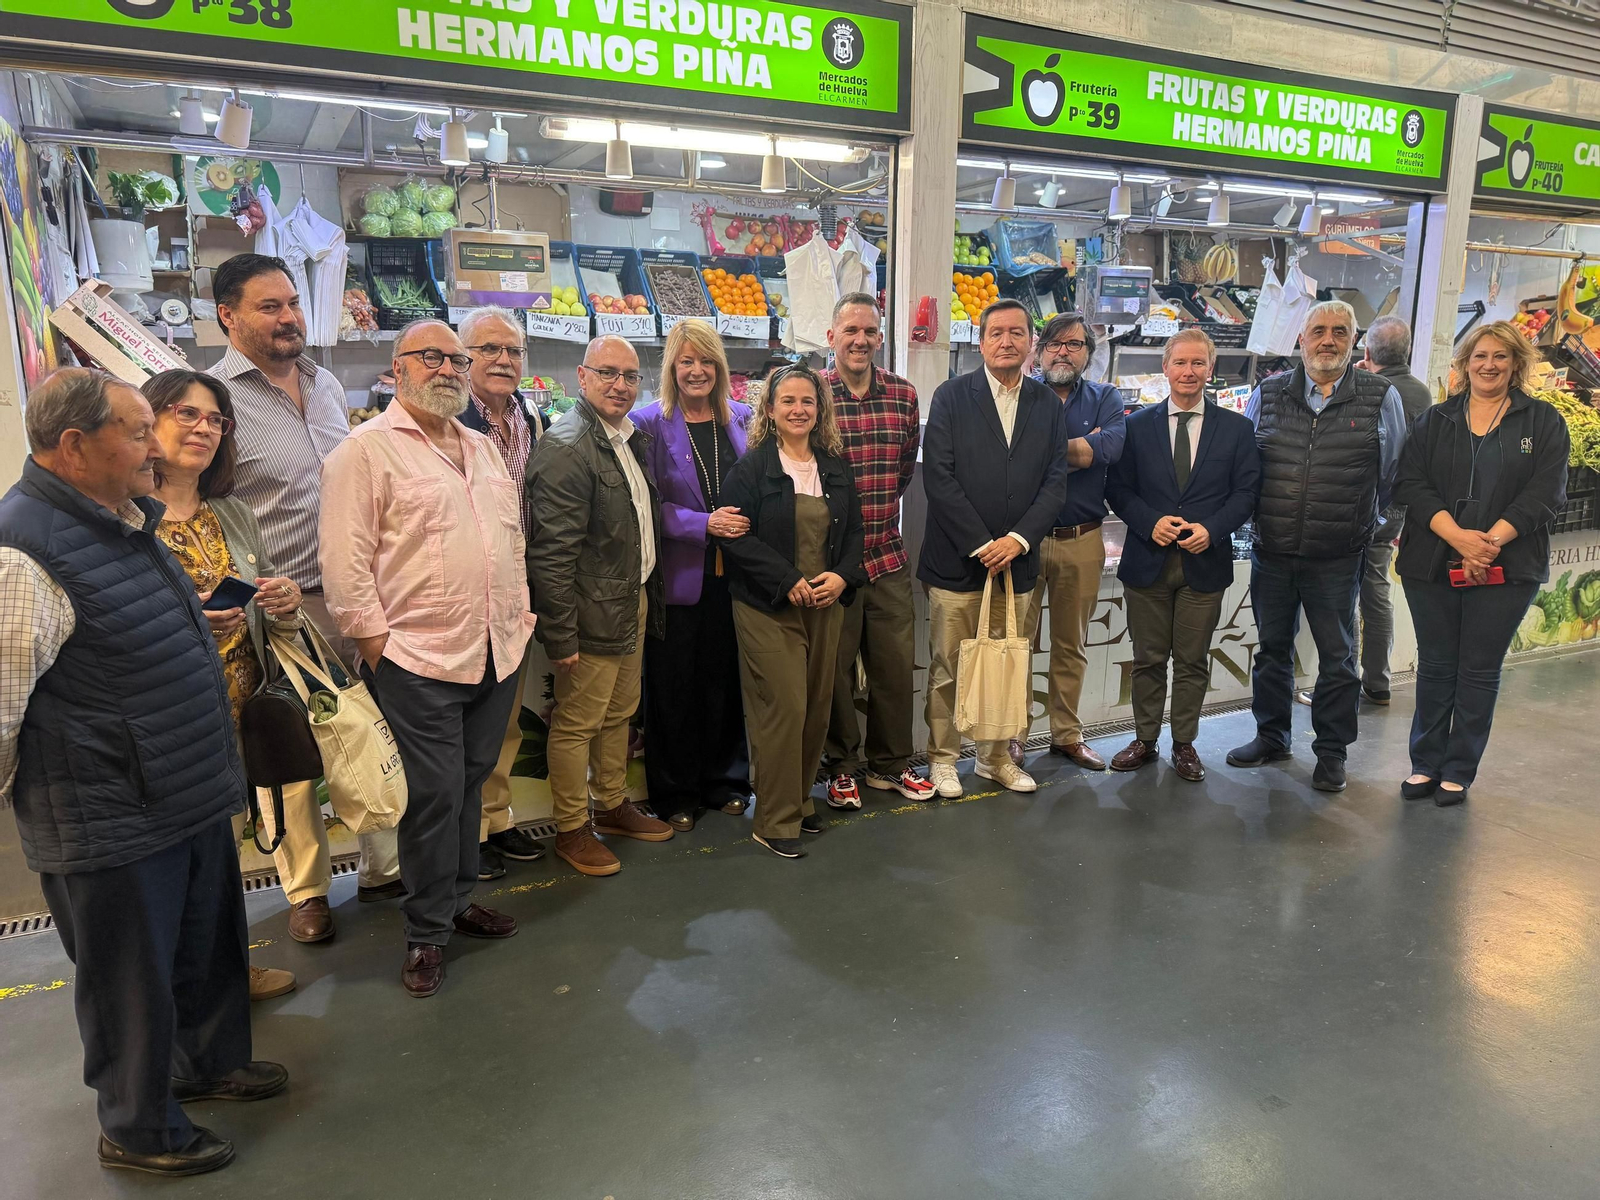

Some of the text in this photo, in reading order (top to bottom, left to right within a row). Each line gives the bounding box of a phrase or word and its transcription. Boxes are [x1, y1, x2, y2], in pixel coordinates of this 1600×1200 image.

[594, 0, 813, 51] VERDURAS
[397, 8, 772, 89] HERMANOS PIÑA
[819, 71, 868, 86] Mercados
[819, 82, 868, 97] de Huelva
[1147, 70, 1398, 135] FRUTAS Y VERDURAS
[1172, 111, 1372, 163] HERMANOS PIÑA
[1396, 149, 1424, 159] Mercados
[1395, 157, 1424, 168] de Huelva
[98, 311, 142, 349] Miguel
